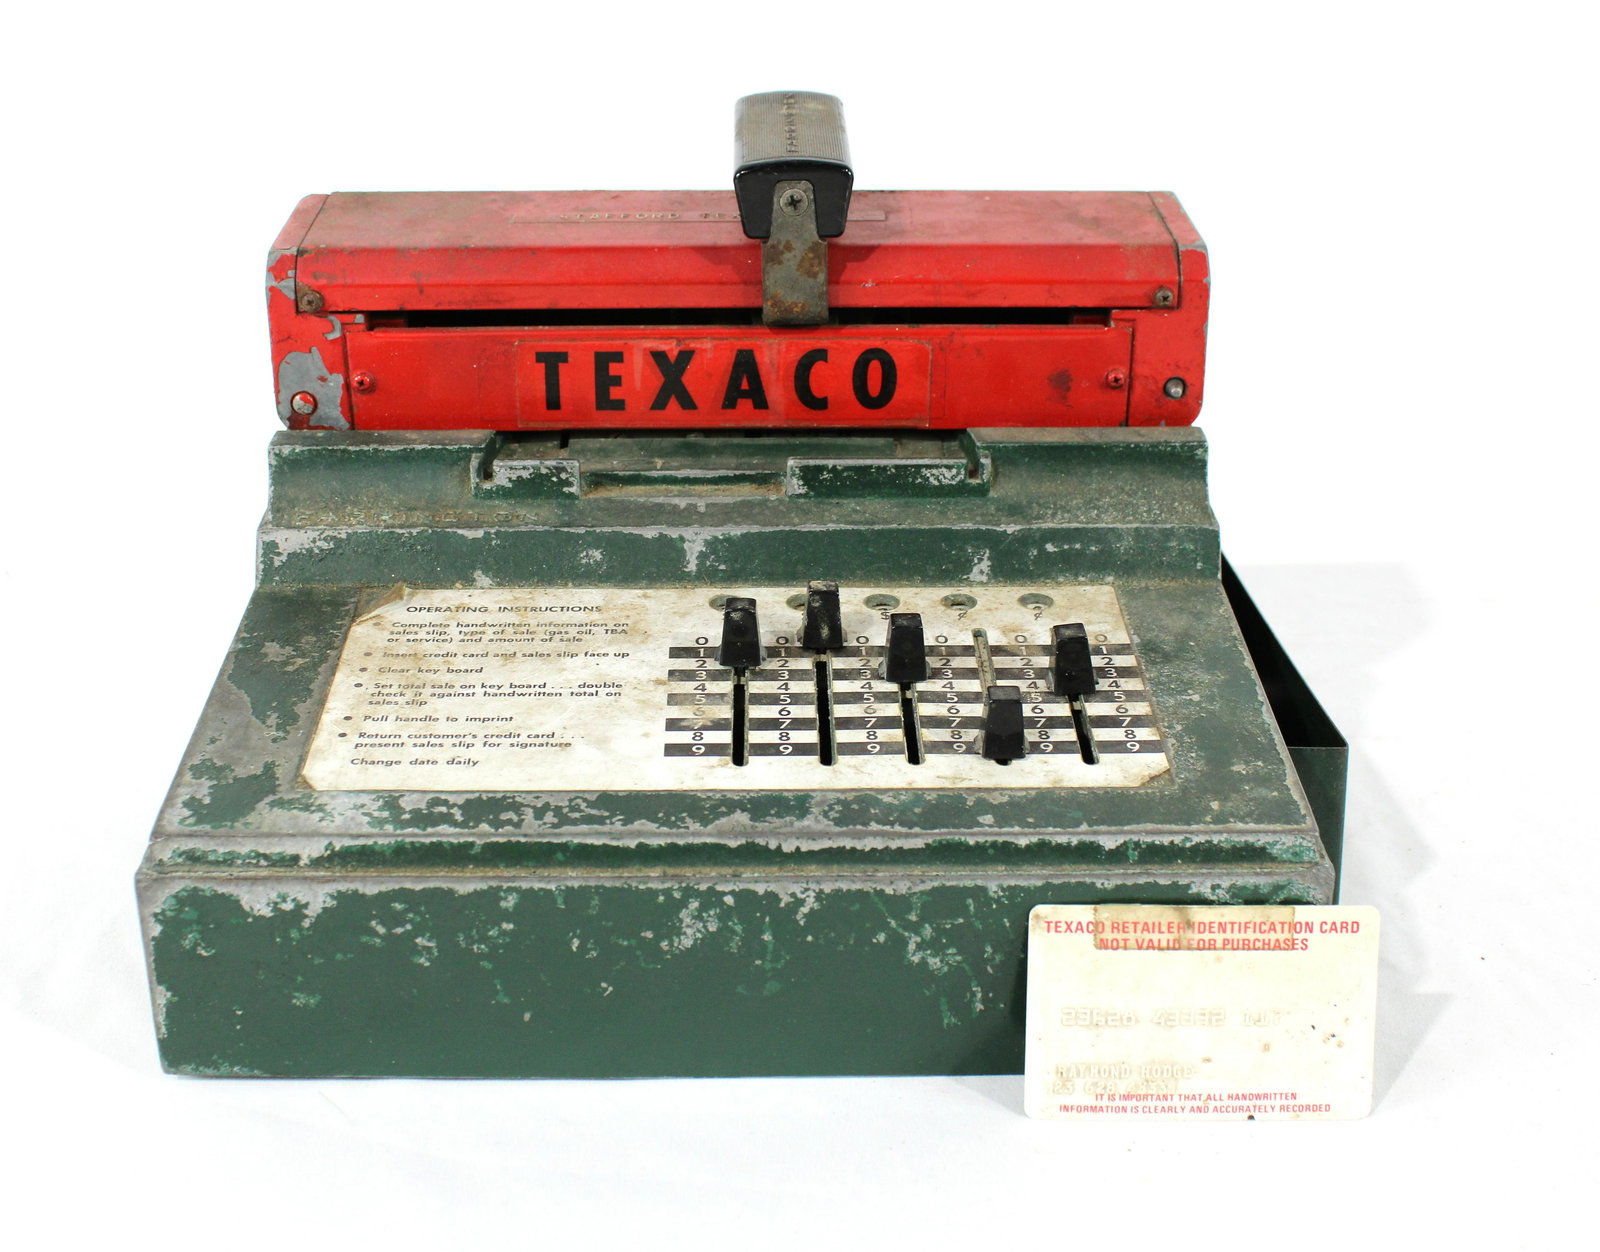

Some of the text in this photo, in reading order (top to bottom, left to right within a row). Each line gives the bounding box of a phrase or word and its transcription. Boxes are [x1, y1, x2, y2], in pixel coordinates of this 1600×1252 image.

[535, 347, 897, 411] TEXACO
[497, 605, 602, 613] INSTRUCTIONS
[425, 629, 450, 637] slip,
[544, 629, 570, 637] (gas
[406, 636, 453, 644] service)
[696, 634, 1107, 645] 0 0 0 0 0 0
[556, 651, 579, 659] slip
[698, 646, 1107, 656] 1 1 1 1 1 1
[696, 660, 707, 668] 2
[858, 659, 871, 667] 2
[939, 658, 952, 667] 2
[1020, 658, 1033, 666] 2
[1101, 657, 1114, 665] 2
[417, 667, 440, 675] key
[446, 666, 484, 674] board
[696, 668, 1117, 679] 3 3 3 3 3 3
[480, 682, 503, 691] key
[694, 680, 1121, 692] 4 4 4 4 4 4
[430, 690, 476, 699] against
[695, 692, 1125, 704] 5 5 5 5 5 5
[405, 699, 428, 707] slip
[779, 707, 791, 716] 6
[864, 705, 877, 714] 6
[947, 705, 960, 714] 6
[1031, 705, 1044, 714] 6
[1116, 704, 1128, 714] 6
[465, 715, 514, 723] imprint
[779, 717, 1132, 728] 7 7 7 7 7
[693, 730, 1136, 741] 8 8 8 8 8 8
[354, 741, 405, 749] present
[451, 741, 475, 749] slip
[509, 741, 572, 749] signature
[692, 742, 1140, 755] 9 9 9 9 9 9
[350, 758, 480, 767] Change date daily
[1045, 920, 1360, 934] TEXACO RETAILER IDENTIFICATION CARD
[1099, 938, 1309, 951] NOT VALID FOR PURCHASES
[1119, 1093, 1174, 1101] IMPORTANT
[1179, 1093, 1203, 1101] THAT
[1205, 1093, 1224, 1101] ALL
[1227, 1092, 1297, 1101] HANDWRITTEN
[1059, 1104, 1330, 1113] INFORMATION IS CLEARLY AND ACCURATELY RECORDED
